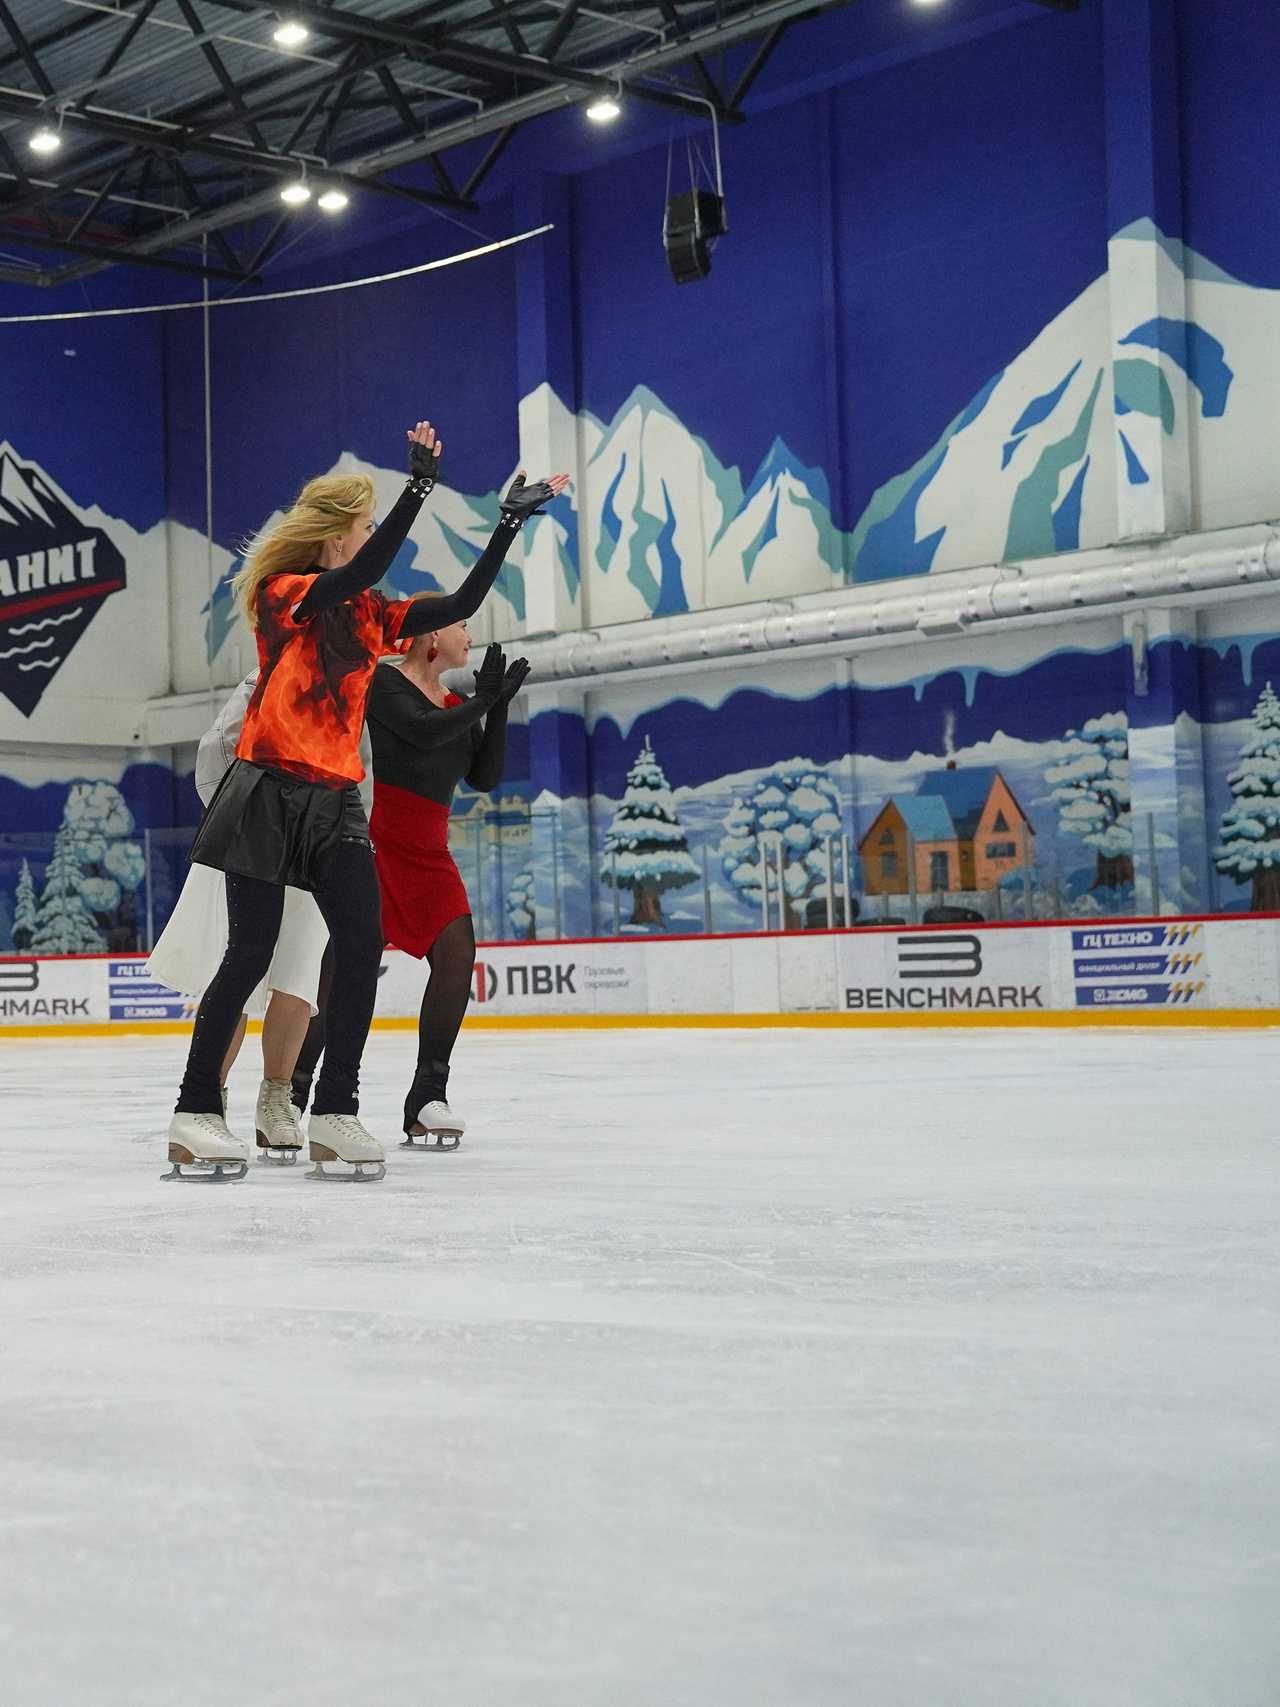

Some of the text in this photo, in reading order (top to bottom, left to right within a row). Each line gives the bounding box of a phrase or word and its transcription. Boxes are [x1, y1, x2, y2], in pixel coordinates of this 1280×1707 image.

[1103, 931, 1154, 946] ТЕХНО
[506, 963, 576, 996] ПВК
[845, 985, 1044, 1009] BENCHMARK
